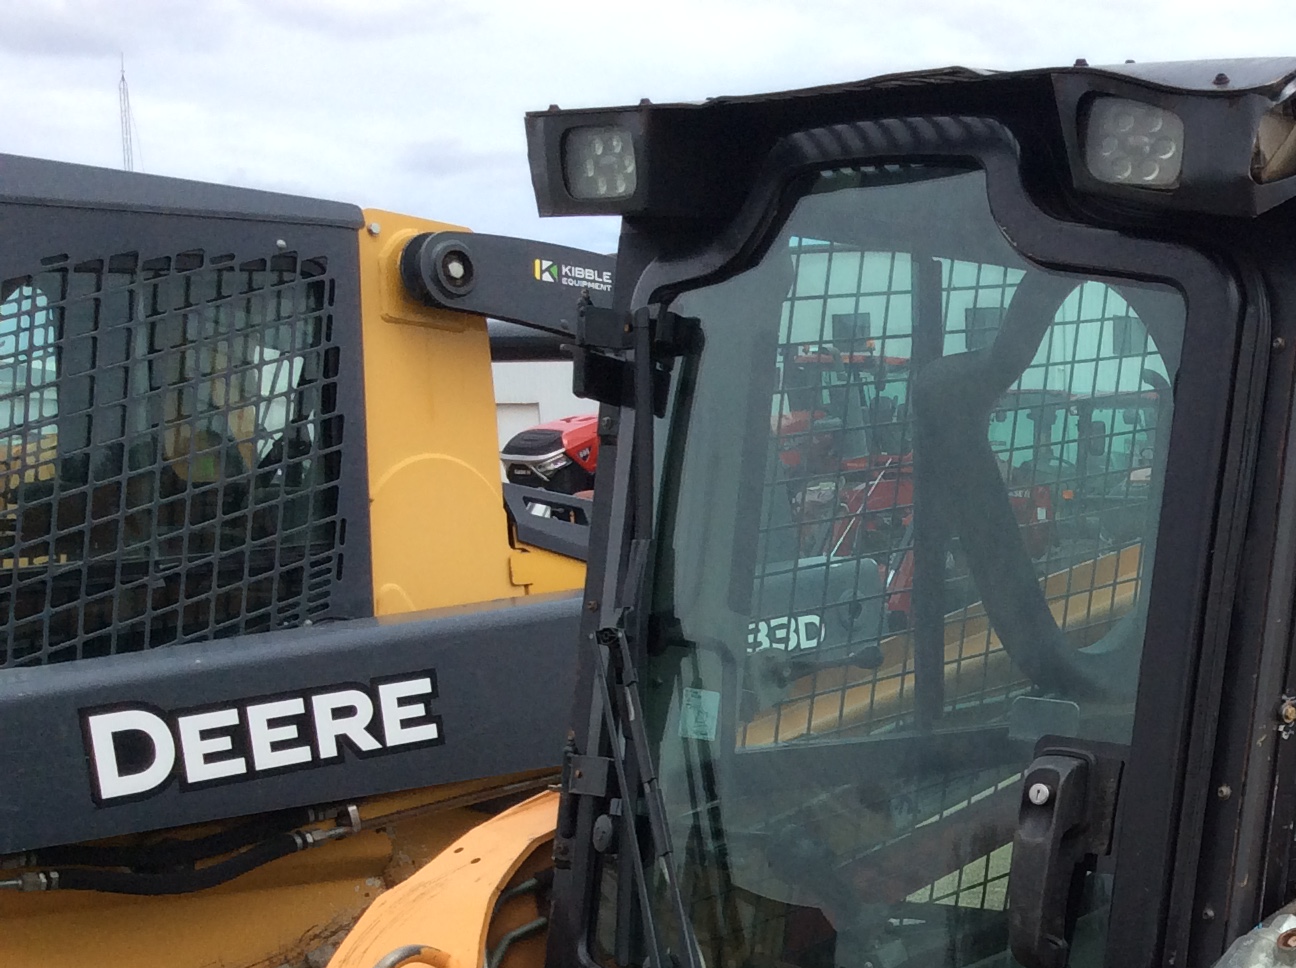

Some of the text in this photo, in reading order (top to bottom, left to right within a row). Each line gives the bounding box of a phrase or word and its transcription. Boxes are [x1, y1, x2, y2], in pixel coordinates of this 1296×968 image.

[561, 264, 613, 283] KIBBLE
[561, 277, 613, 292] EQUIPMENT
[88, 677, 439, 800] DEERE
